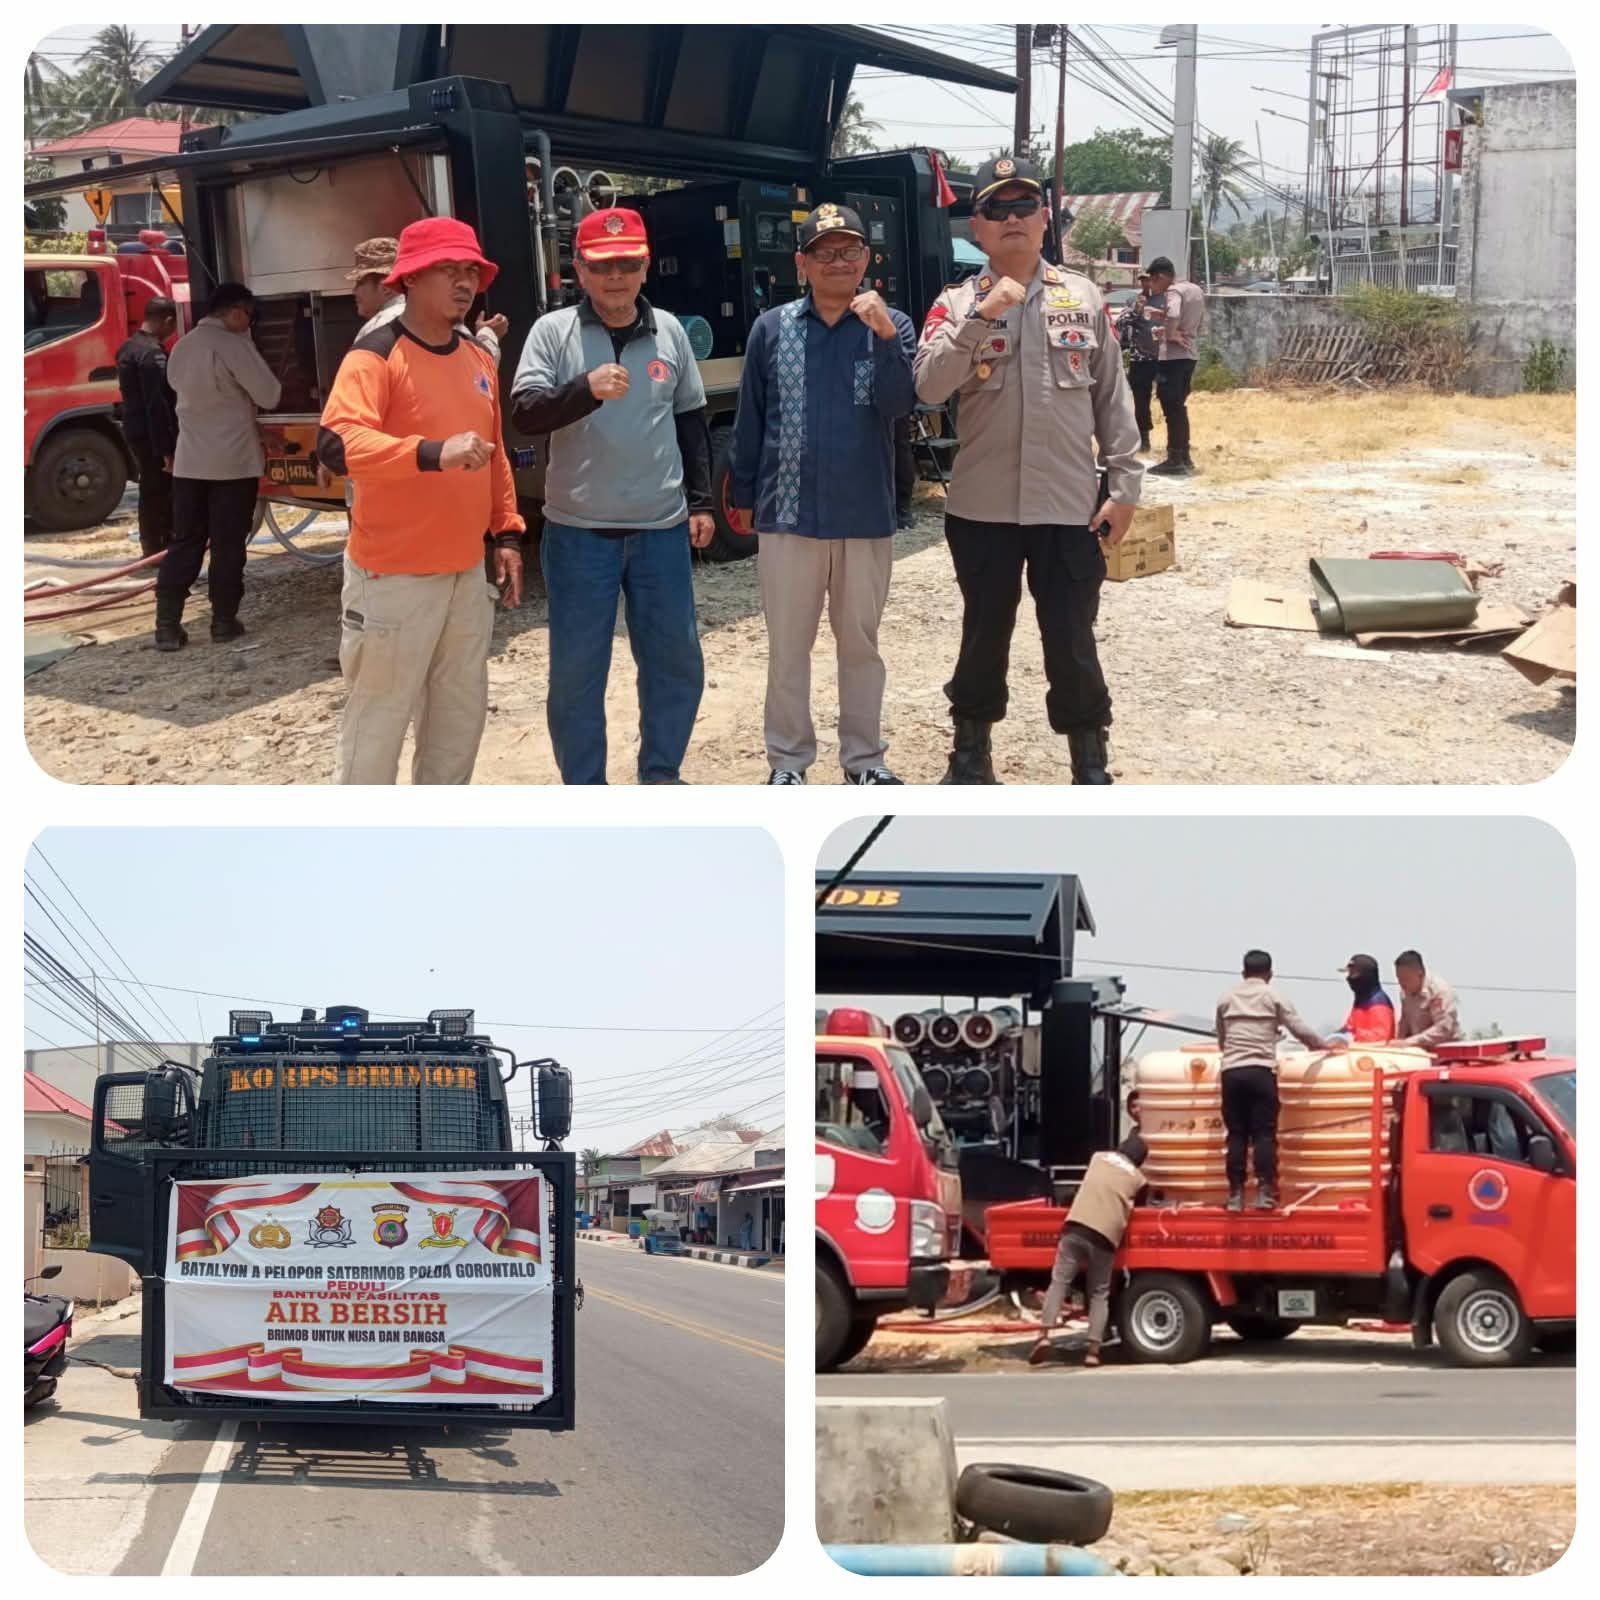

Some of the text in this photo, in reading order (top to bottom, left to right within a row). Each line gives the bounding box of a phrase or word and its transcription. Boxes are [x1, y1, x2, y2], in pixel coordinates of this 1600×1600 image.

[1047, 312, 1089, 326] POLRI
[229, 1064, 477, 1092] KORPS BRIMOB
[180, 1261, 536, 1281] BATALYON A PELOPOR SATBRIMOB POLDA GORONTALO
[327, 1281, 386, 1292] PEDULI
[272, 1291, 441, 1301] BANTUAN FASILITAS
[264, 1302, 448, 1326] AIR BERSIH
[267, 1328, 446, 1344] BRIMOB UNTUK NUSA DAN BANGSA
